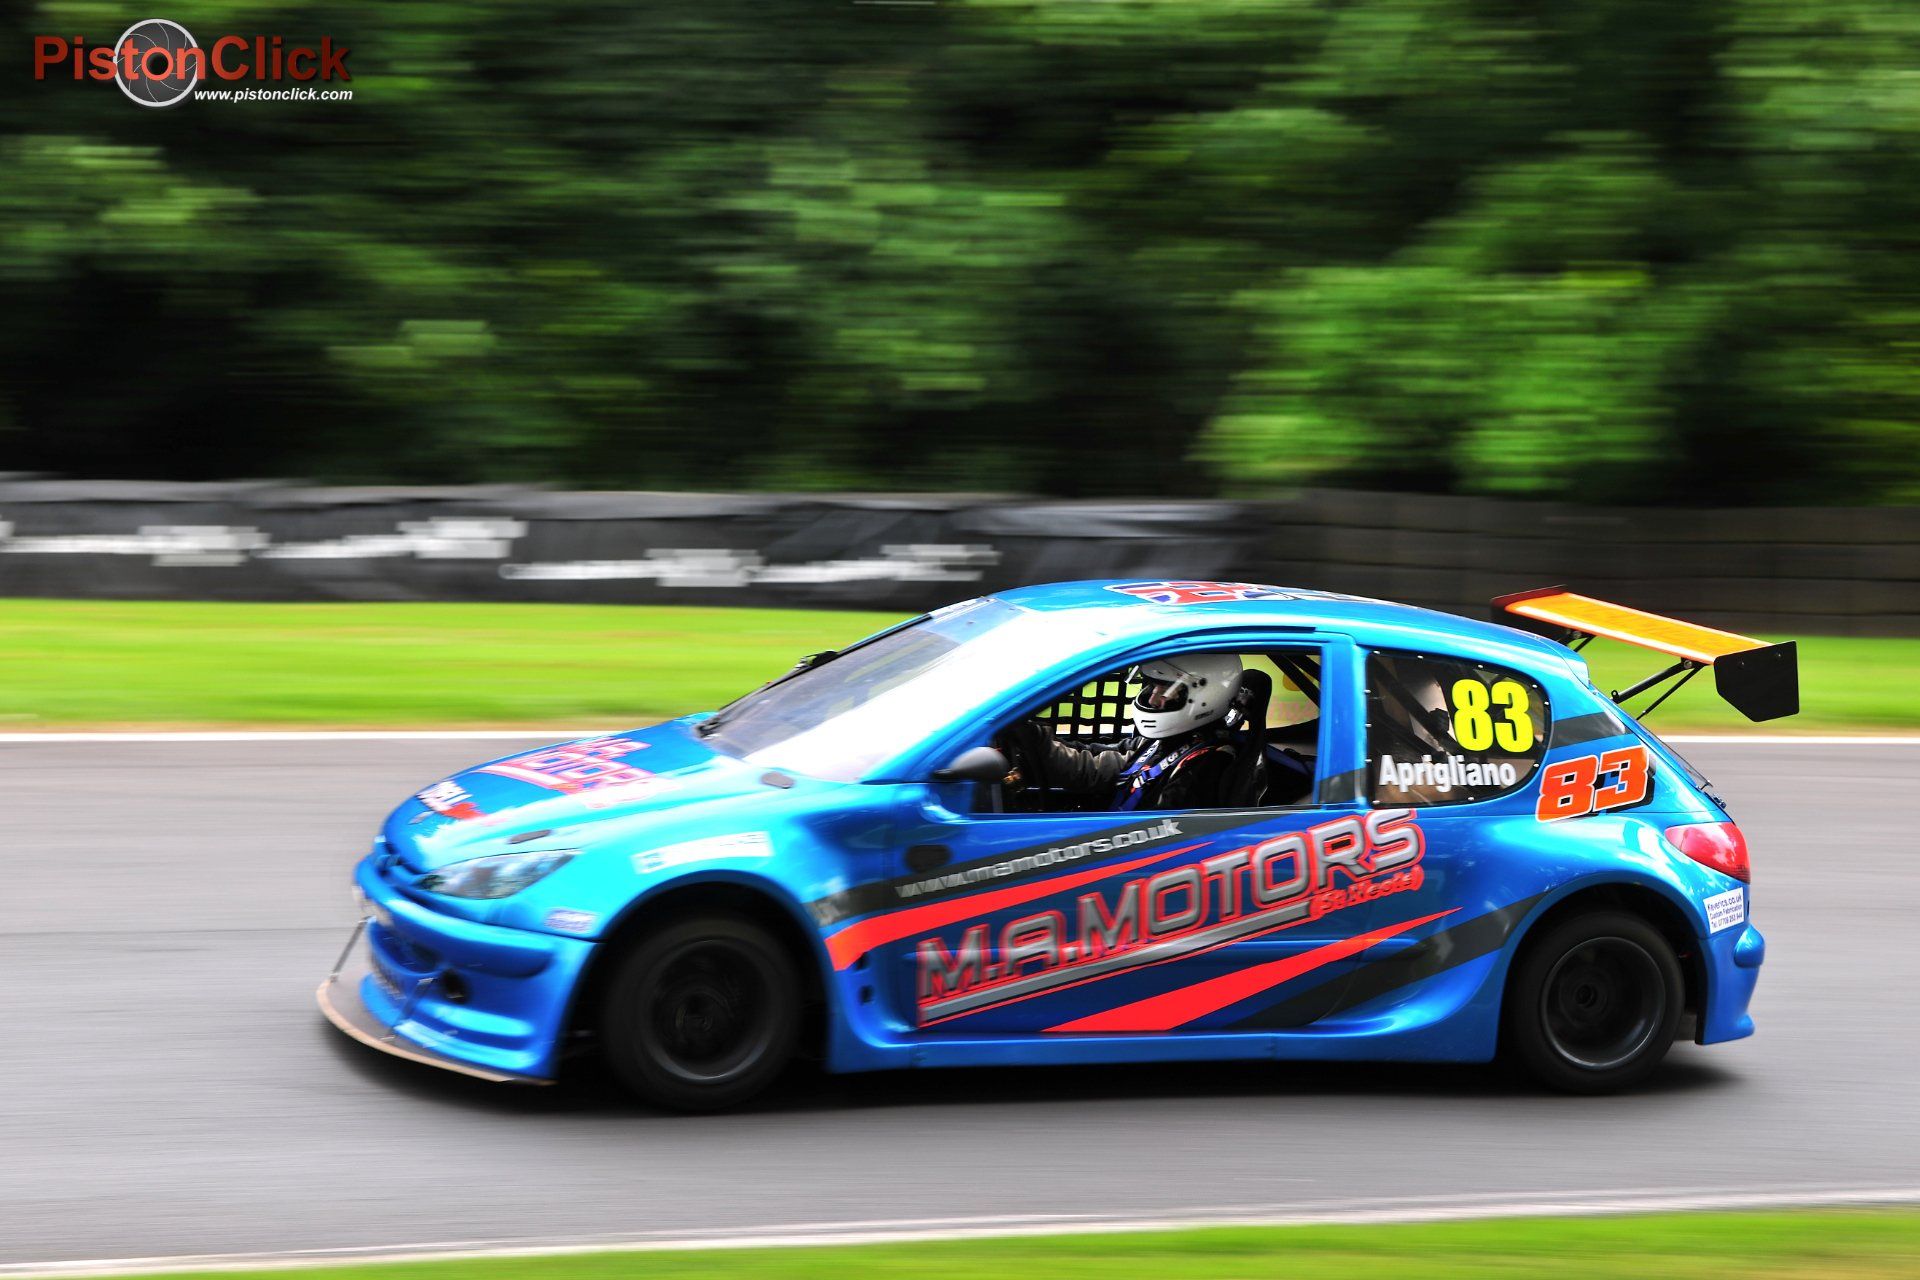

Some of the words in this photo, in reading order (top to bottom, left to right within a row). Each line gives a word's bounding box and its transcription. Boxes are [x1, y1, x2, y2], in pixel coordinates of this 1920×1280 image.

[1452, 679, 1534, 753] 83
[1379, 755, 1517, 793] Aprigliano
[1536, 745, 1650, 823] 83
